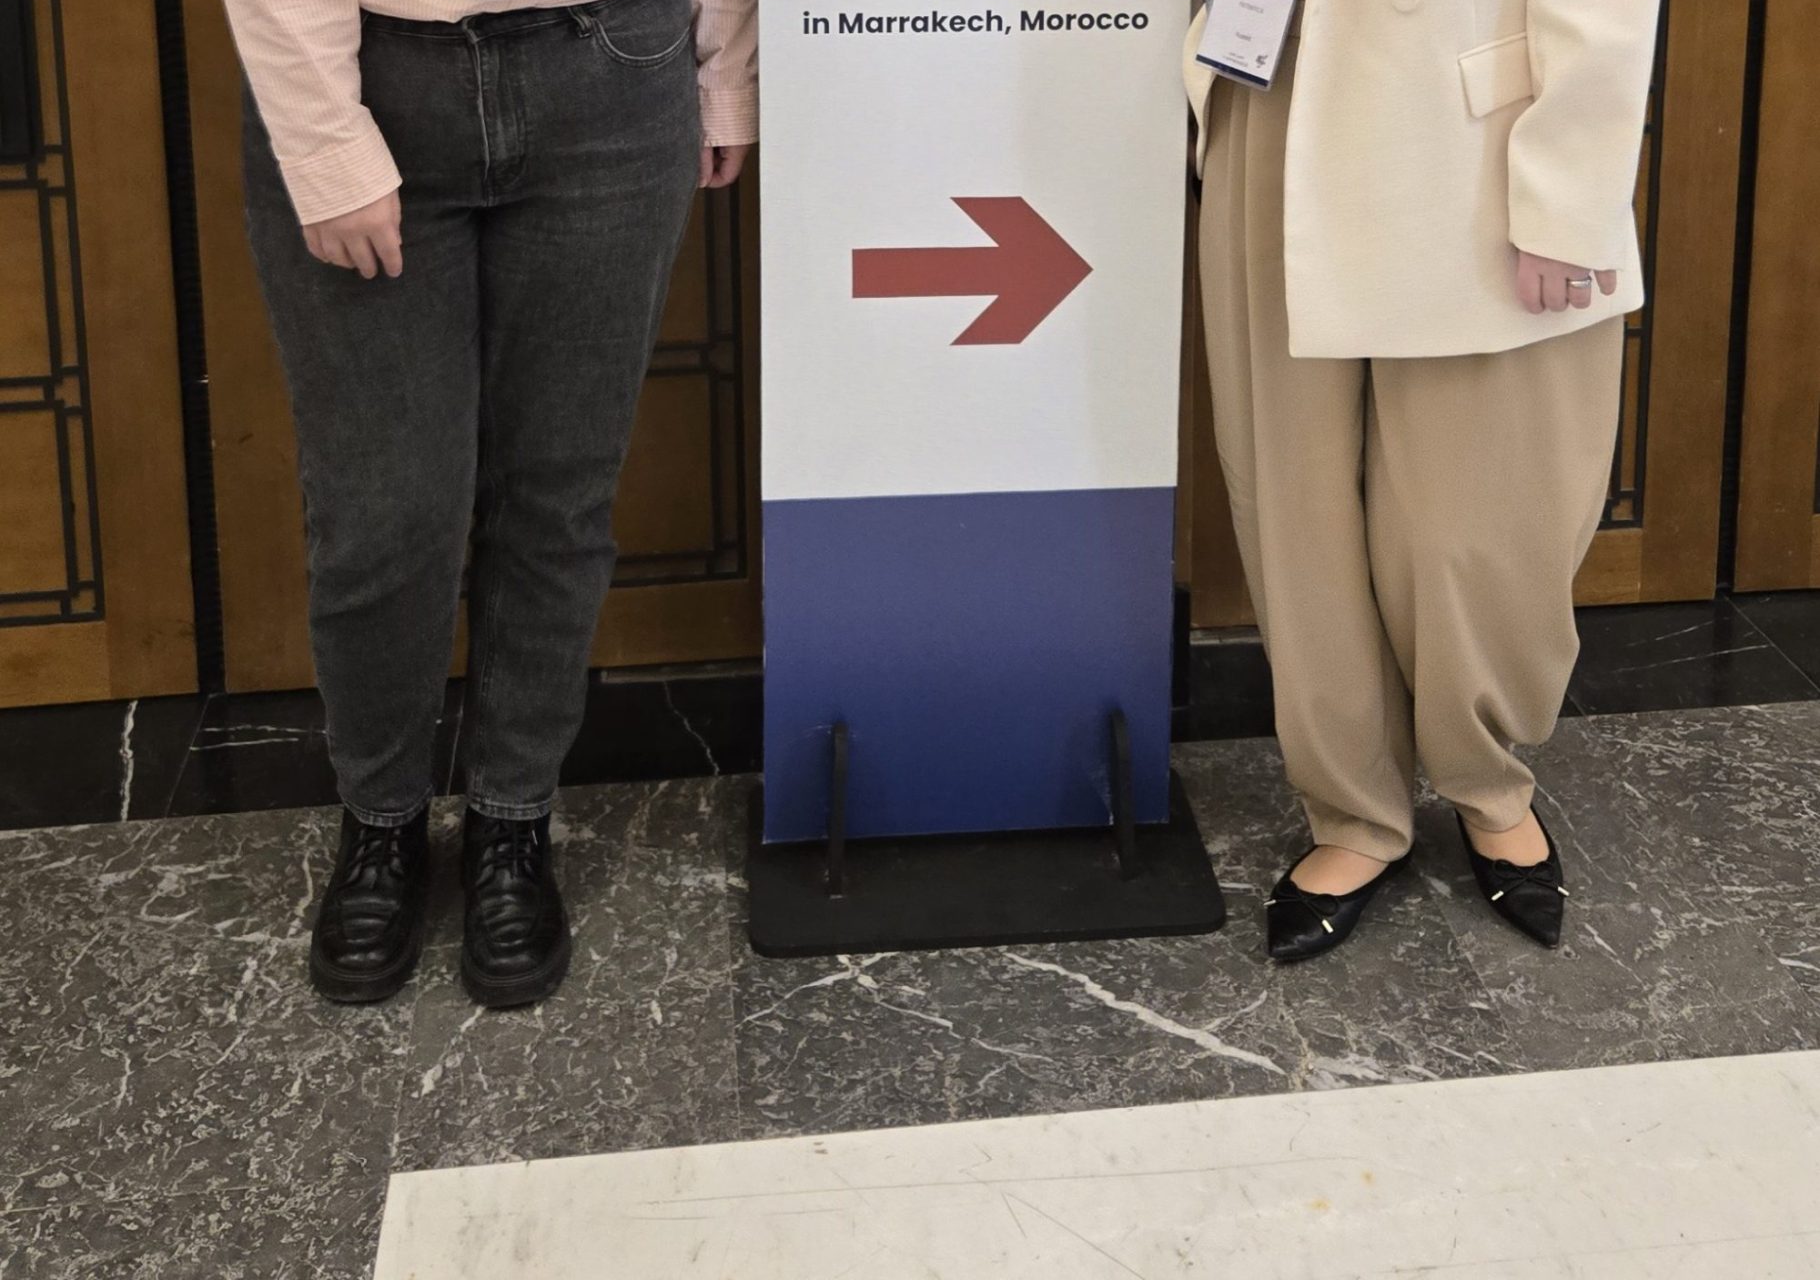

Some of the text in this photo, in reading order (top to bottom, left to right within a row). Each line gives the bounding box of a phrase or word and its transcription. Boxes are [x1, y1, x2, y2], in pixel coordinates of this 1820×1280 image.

[803, 10, 1148, 34] in Marrakech, Morocco
